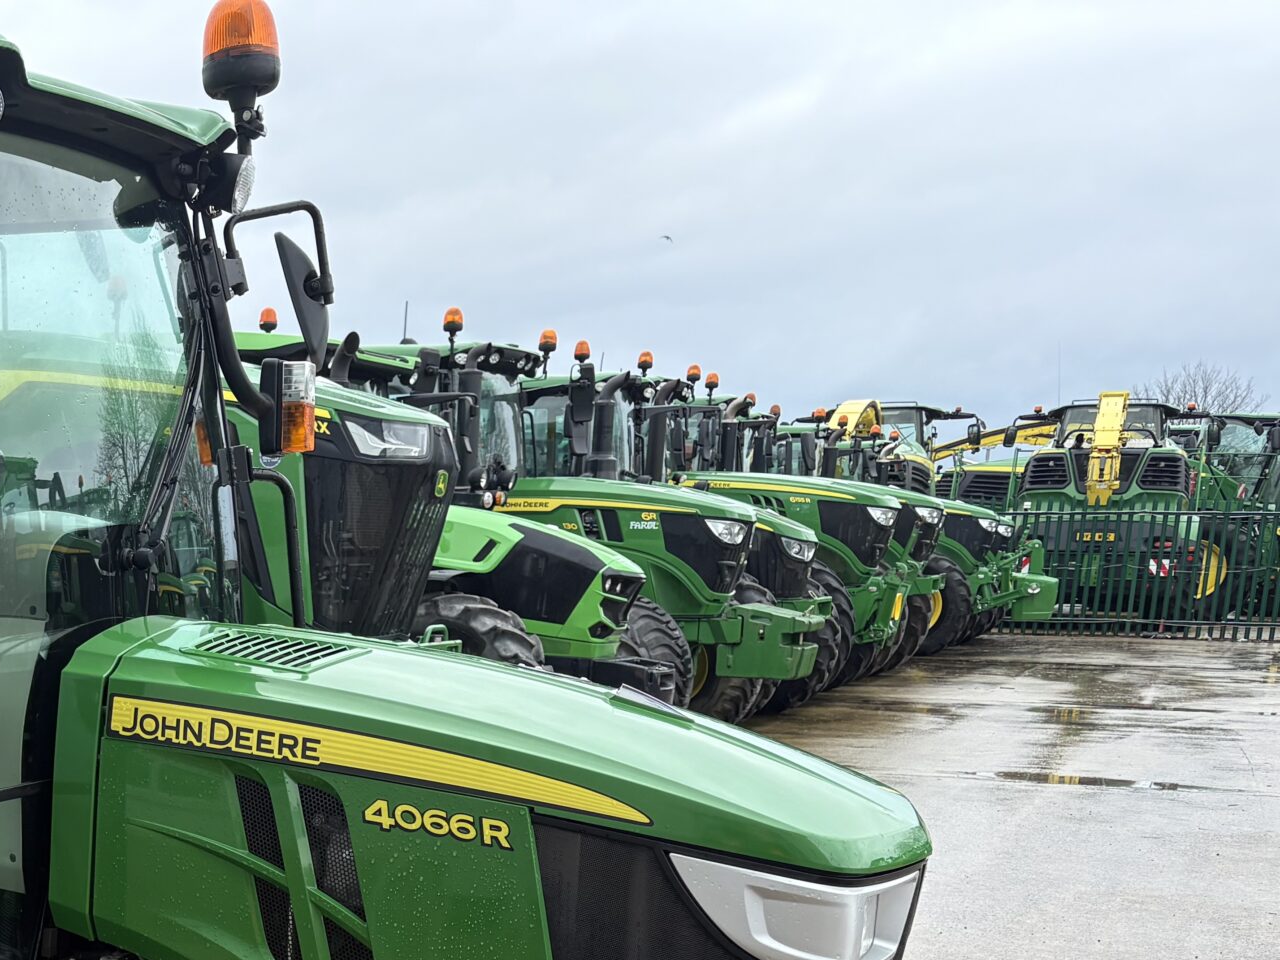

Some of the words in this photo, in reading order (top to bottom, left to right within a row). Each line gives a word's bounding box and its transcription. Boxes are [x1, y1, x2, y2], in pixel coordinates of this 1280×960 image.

[523, 500, 549, 508] DEERE
[122, 706, 204, 744] JOHN
[209, 718, 322, 762] DEERE
